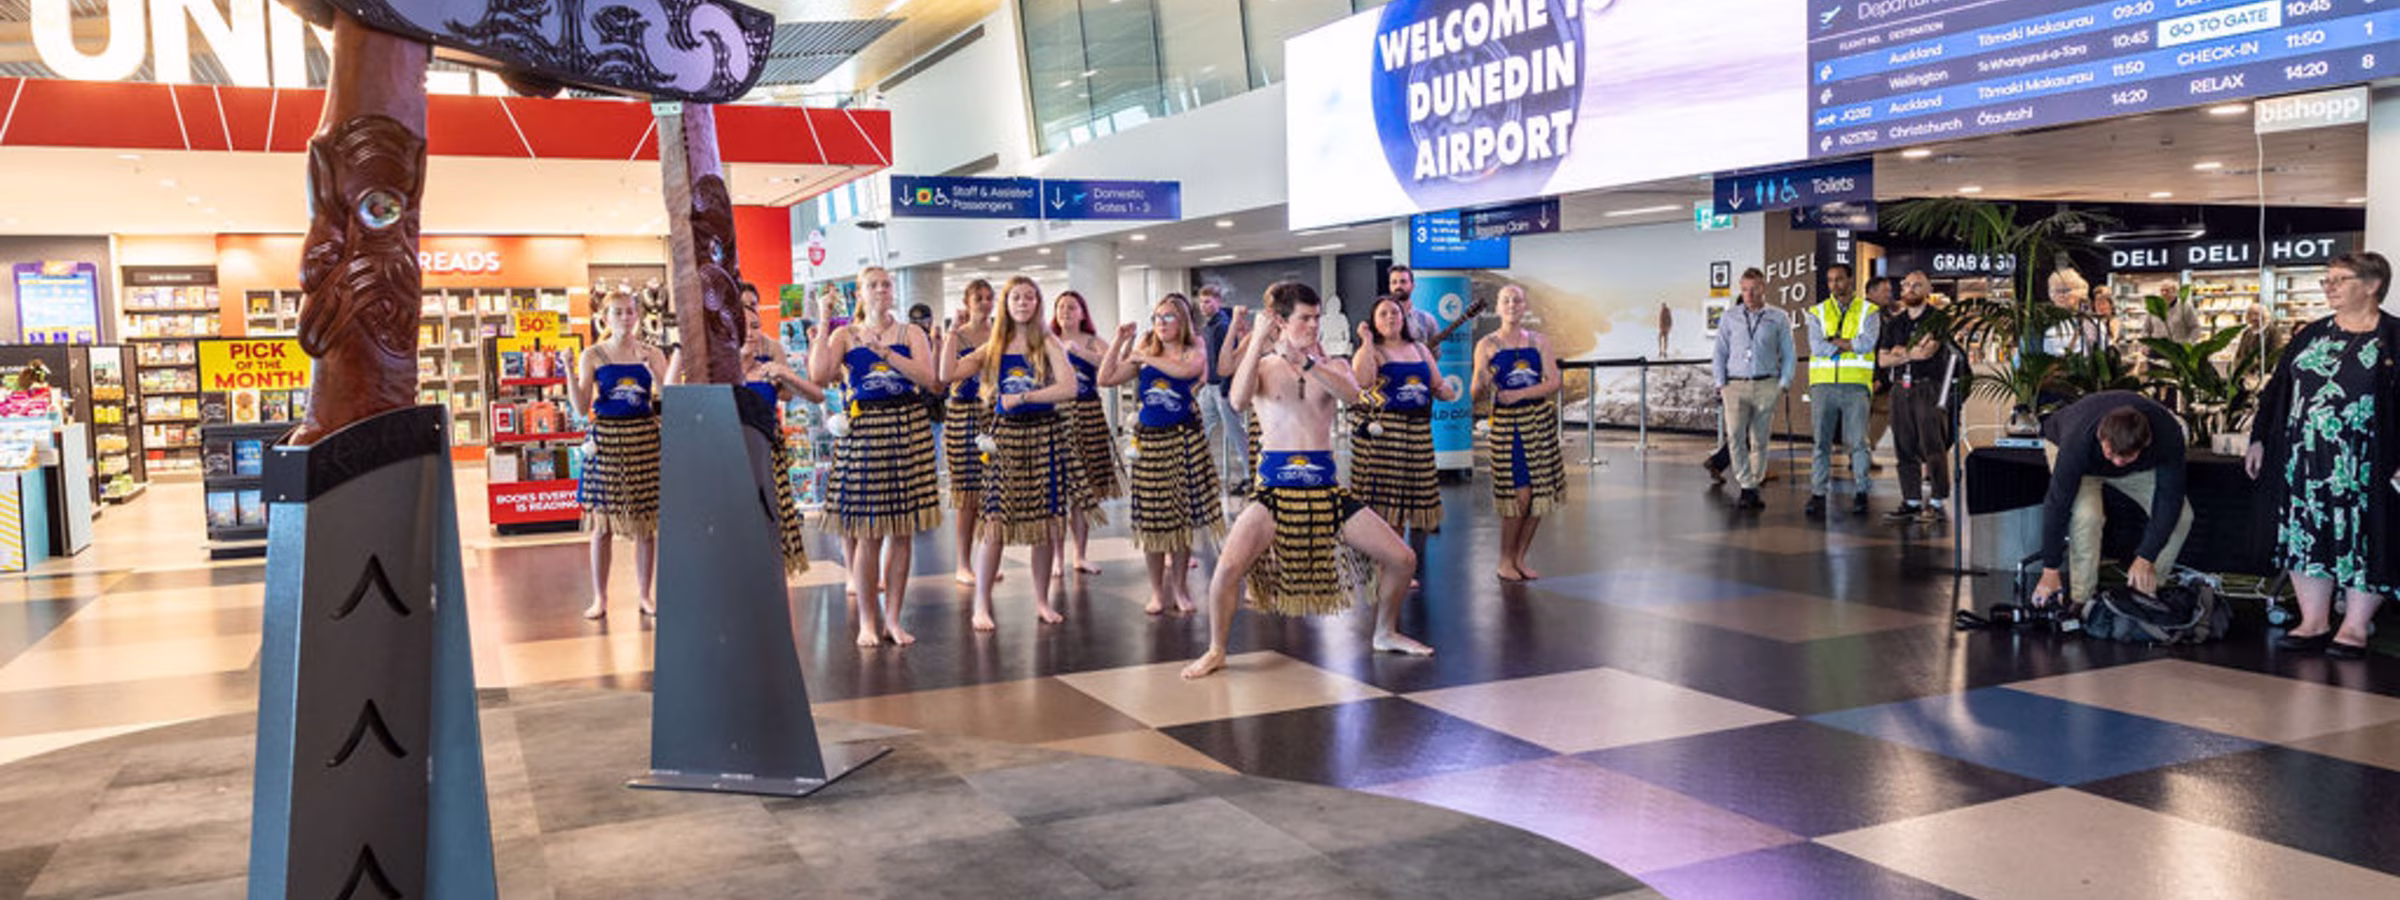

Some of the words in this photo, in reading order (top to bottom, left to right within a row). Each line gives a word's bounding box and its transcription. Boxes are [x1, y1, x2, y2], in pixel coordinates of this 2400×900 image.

[1378, 0, 1548, 72] WELCOME
[1888, 43, 1942, 65] Auckland
[2112, 0, 2155, 19] 09:30
[1888, 70, 1948, 90] Wellington
[2112, 30, 2149, 48] 10:45
[2169, 22, 2194, 37] GO
[2199, 17, 2221, 32] TO
[2223, 7, 2269, 27] GATE
[1888, 95, 1942, 114] Auckland
[2112, 60, 2145, 77] 11:50
[2177, 41, 2258, 66] CHECK-IN
[2285, 30, 2326, 48] 11:50
[2363, 21, 2374, 36] 1
[1408, 41, 1576, 123] DUNEDIN
[1888, 117, 1962, 139] Christchurch
[2111, 89, 2148, 105] 14:20
[2190, 73, 2244, 95] RELAX
[2283, 61, 2328, 80] 14:20
[2361, 53, 2375, 70] 8
[2260, 96, 2361, 123] bishopp
[1413, 109, 1574, 181] AIRPORT
[953, 185, 978, 197] Staff
[990, 187, 1034, 199] Assisted
[1093, 187, 1145, 200] Domestic
[1812, 176, 1855, 194] Toilets
[952, 199, 1014, 212] Passengers
[1094, 202, 1127, 213] Gates
[1416, 227, 1427, 243] 3
[418, 251, 500, 272] READS
[1933, 253, 1977, 271] GRAB
[2112, 249, 2169, 267] DELI
[2189, 244, 2249, 264] DELI
[2272, 239, 2335, 259] HOT
[1766, 253, 1818, 283] FUEL
[1779, 283, 1806, 306] TO
[229, 342, 286, 359] PICK
[235, 361, 253, 370] OF
[258, 359, 282, 370] THE
[214, 371, 305, 389] MONTH
[496, 493, 536, 504] BOOKS
[539, 489, 578, 503] EVERY
[516, 502, 527, 512] IS
[529, 500, 580, 511] READING
